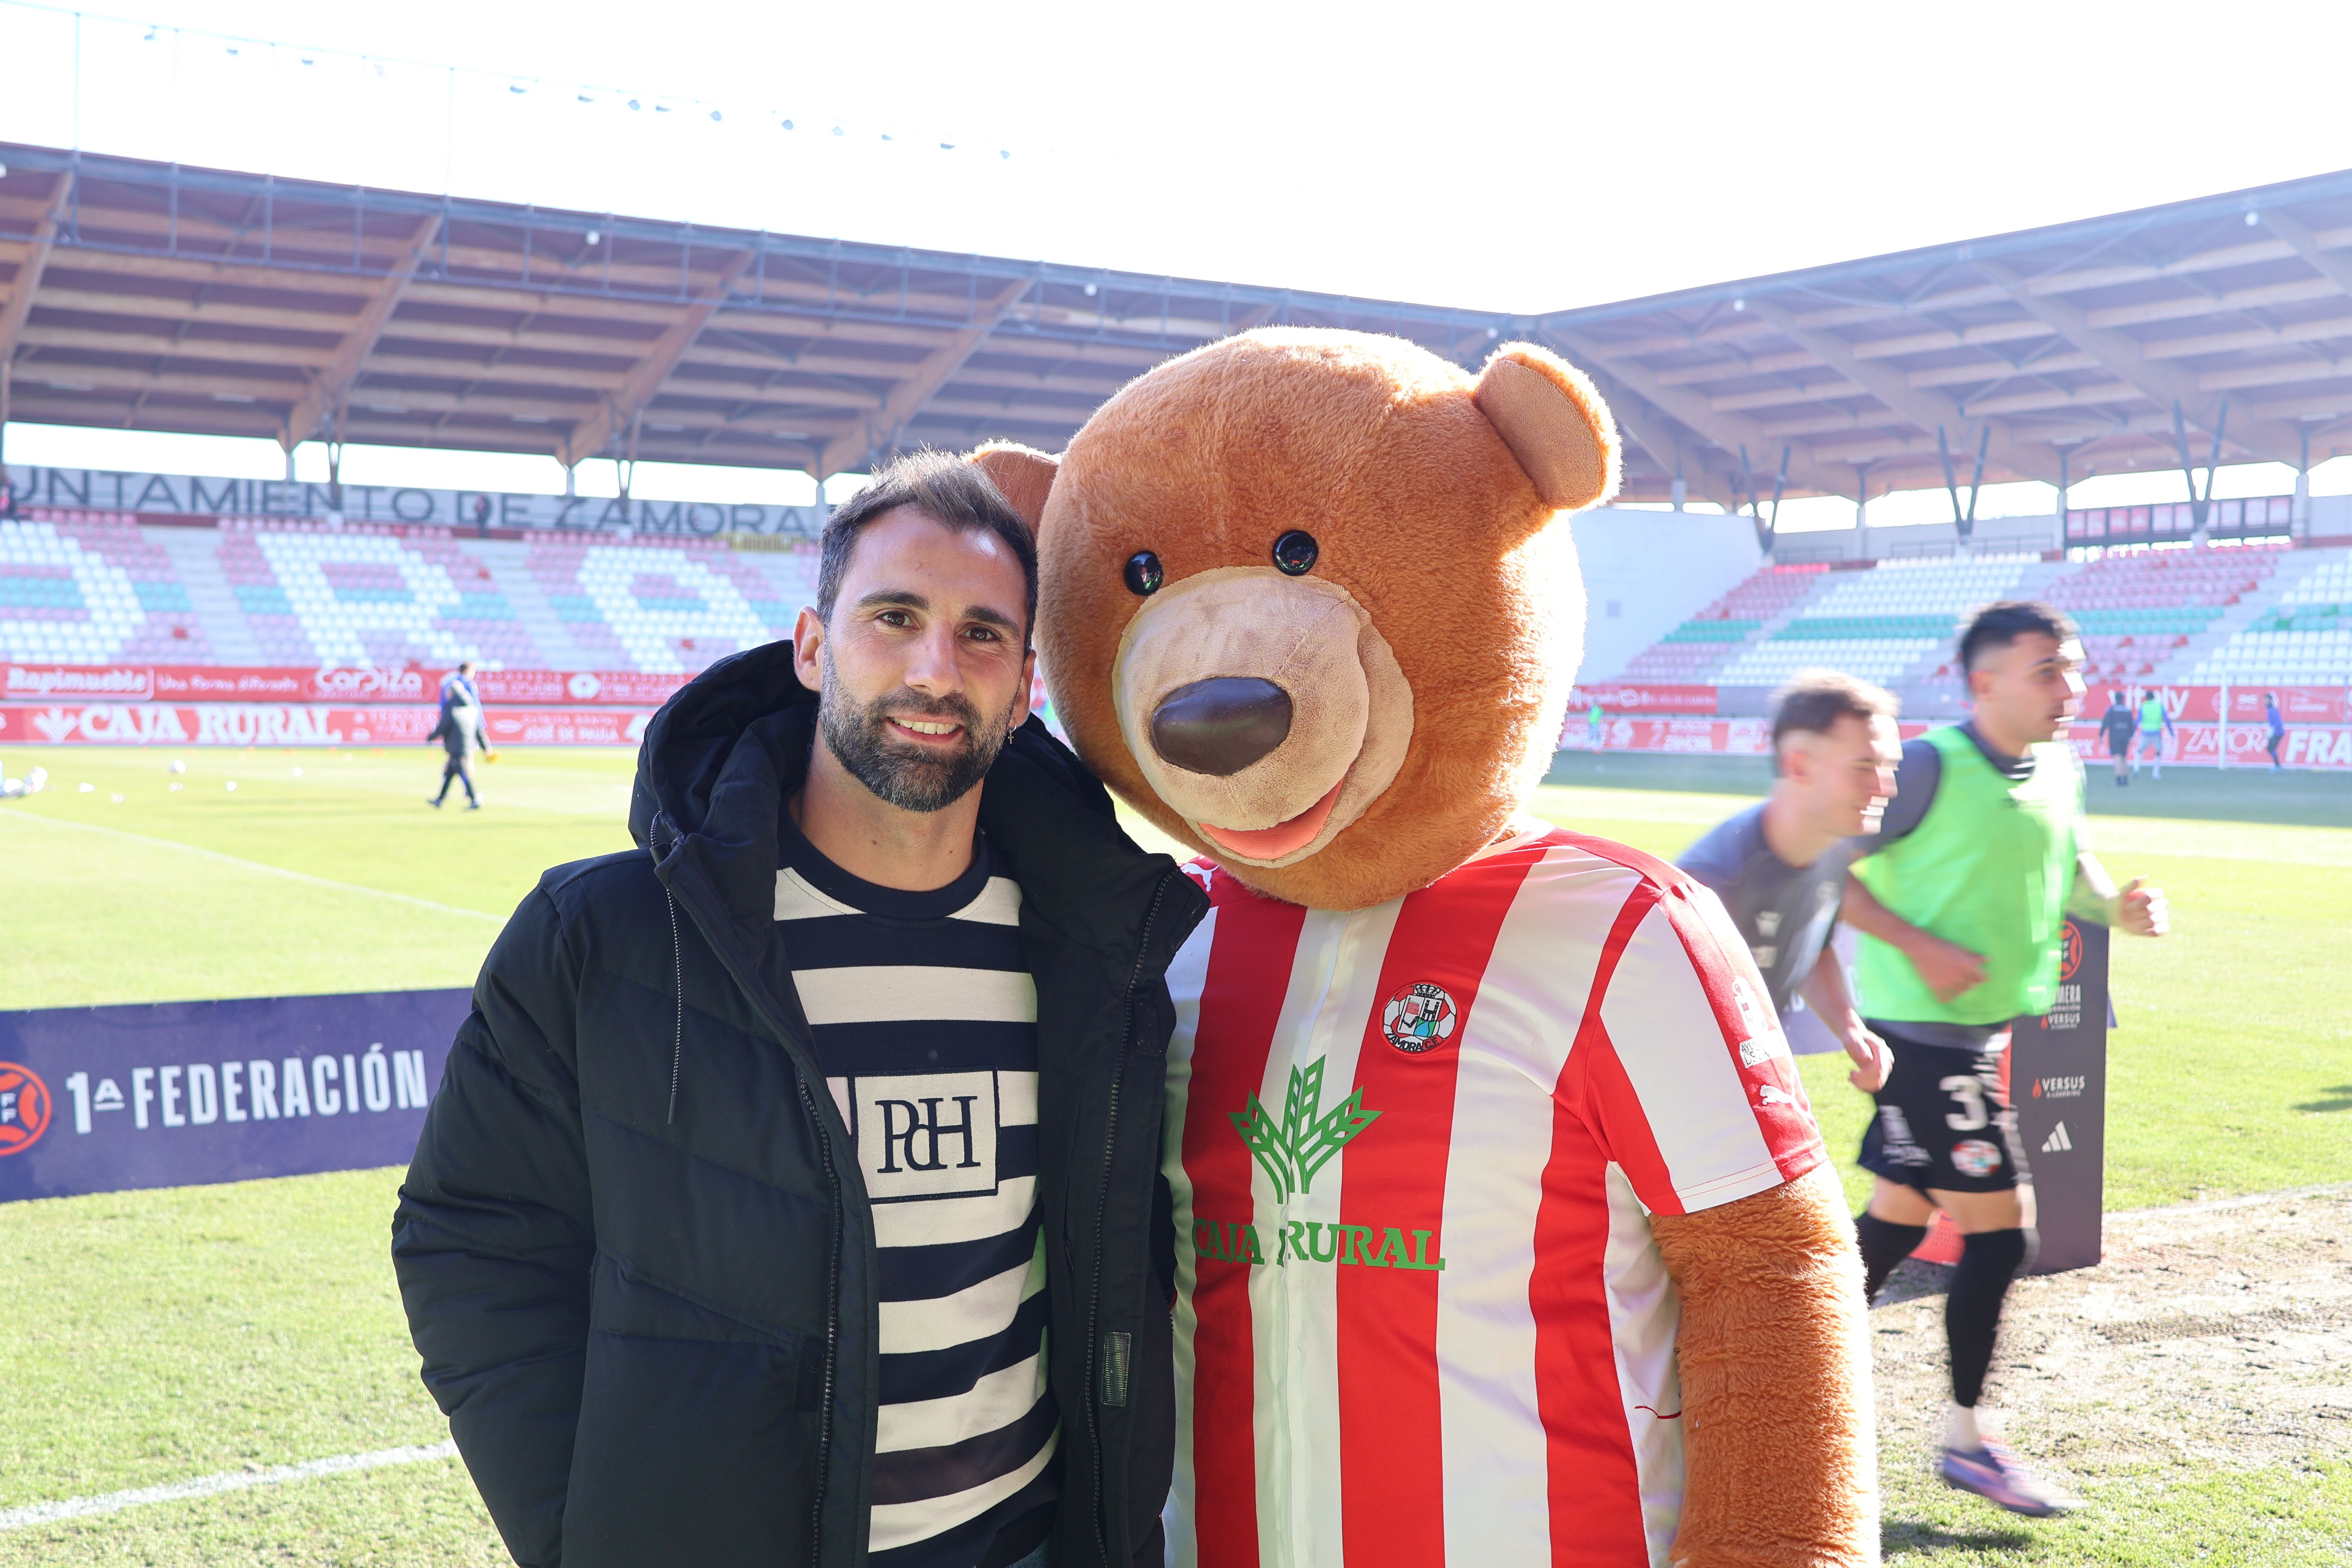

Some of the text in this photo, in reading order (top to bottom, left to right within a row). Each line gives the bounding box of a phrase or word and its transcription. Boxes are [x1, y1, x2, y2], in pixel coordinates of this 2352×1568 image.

[456, 491, 533, 525] DE
[554, 495, 807, 535] ZAMORA
[80, 704, 343, 744] CAJA RURAL
[557, 726, 576, 742] DE
[2047, 1012, 2081, 1026] VERSUS
[1385, 1033, 1423, 1051] ZAMORA
[131, 1042, 429, 1129] FEDERACIÓN
[2042, 1075, 2085, 1092] VERSUS
[1192, 1218, 1446, 1270] CAJA RURAL
